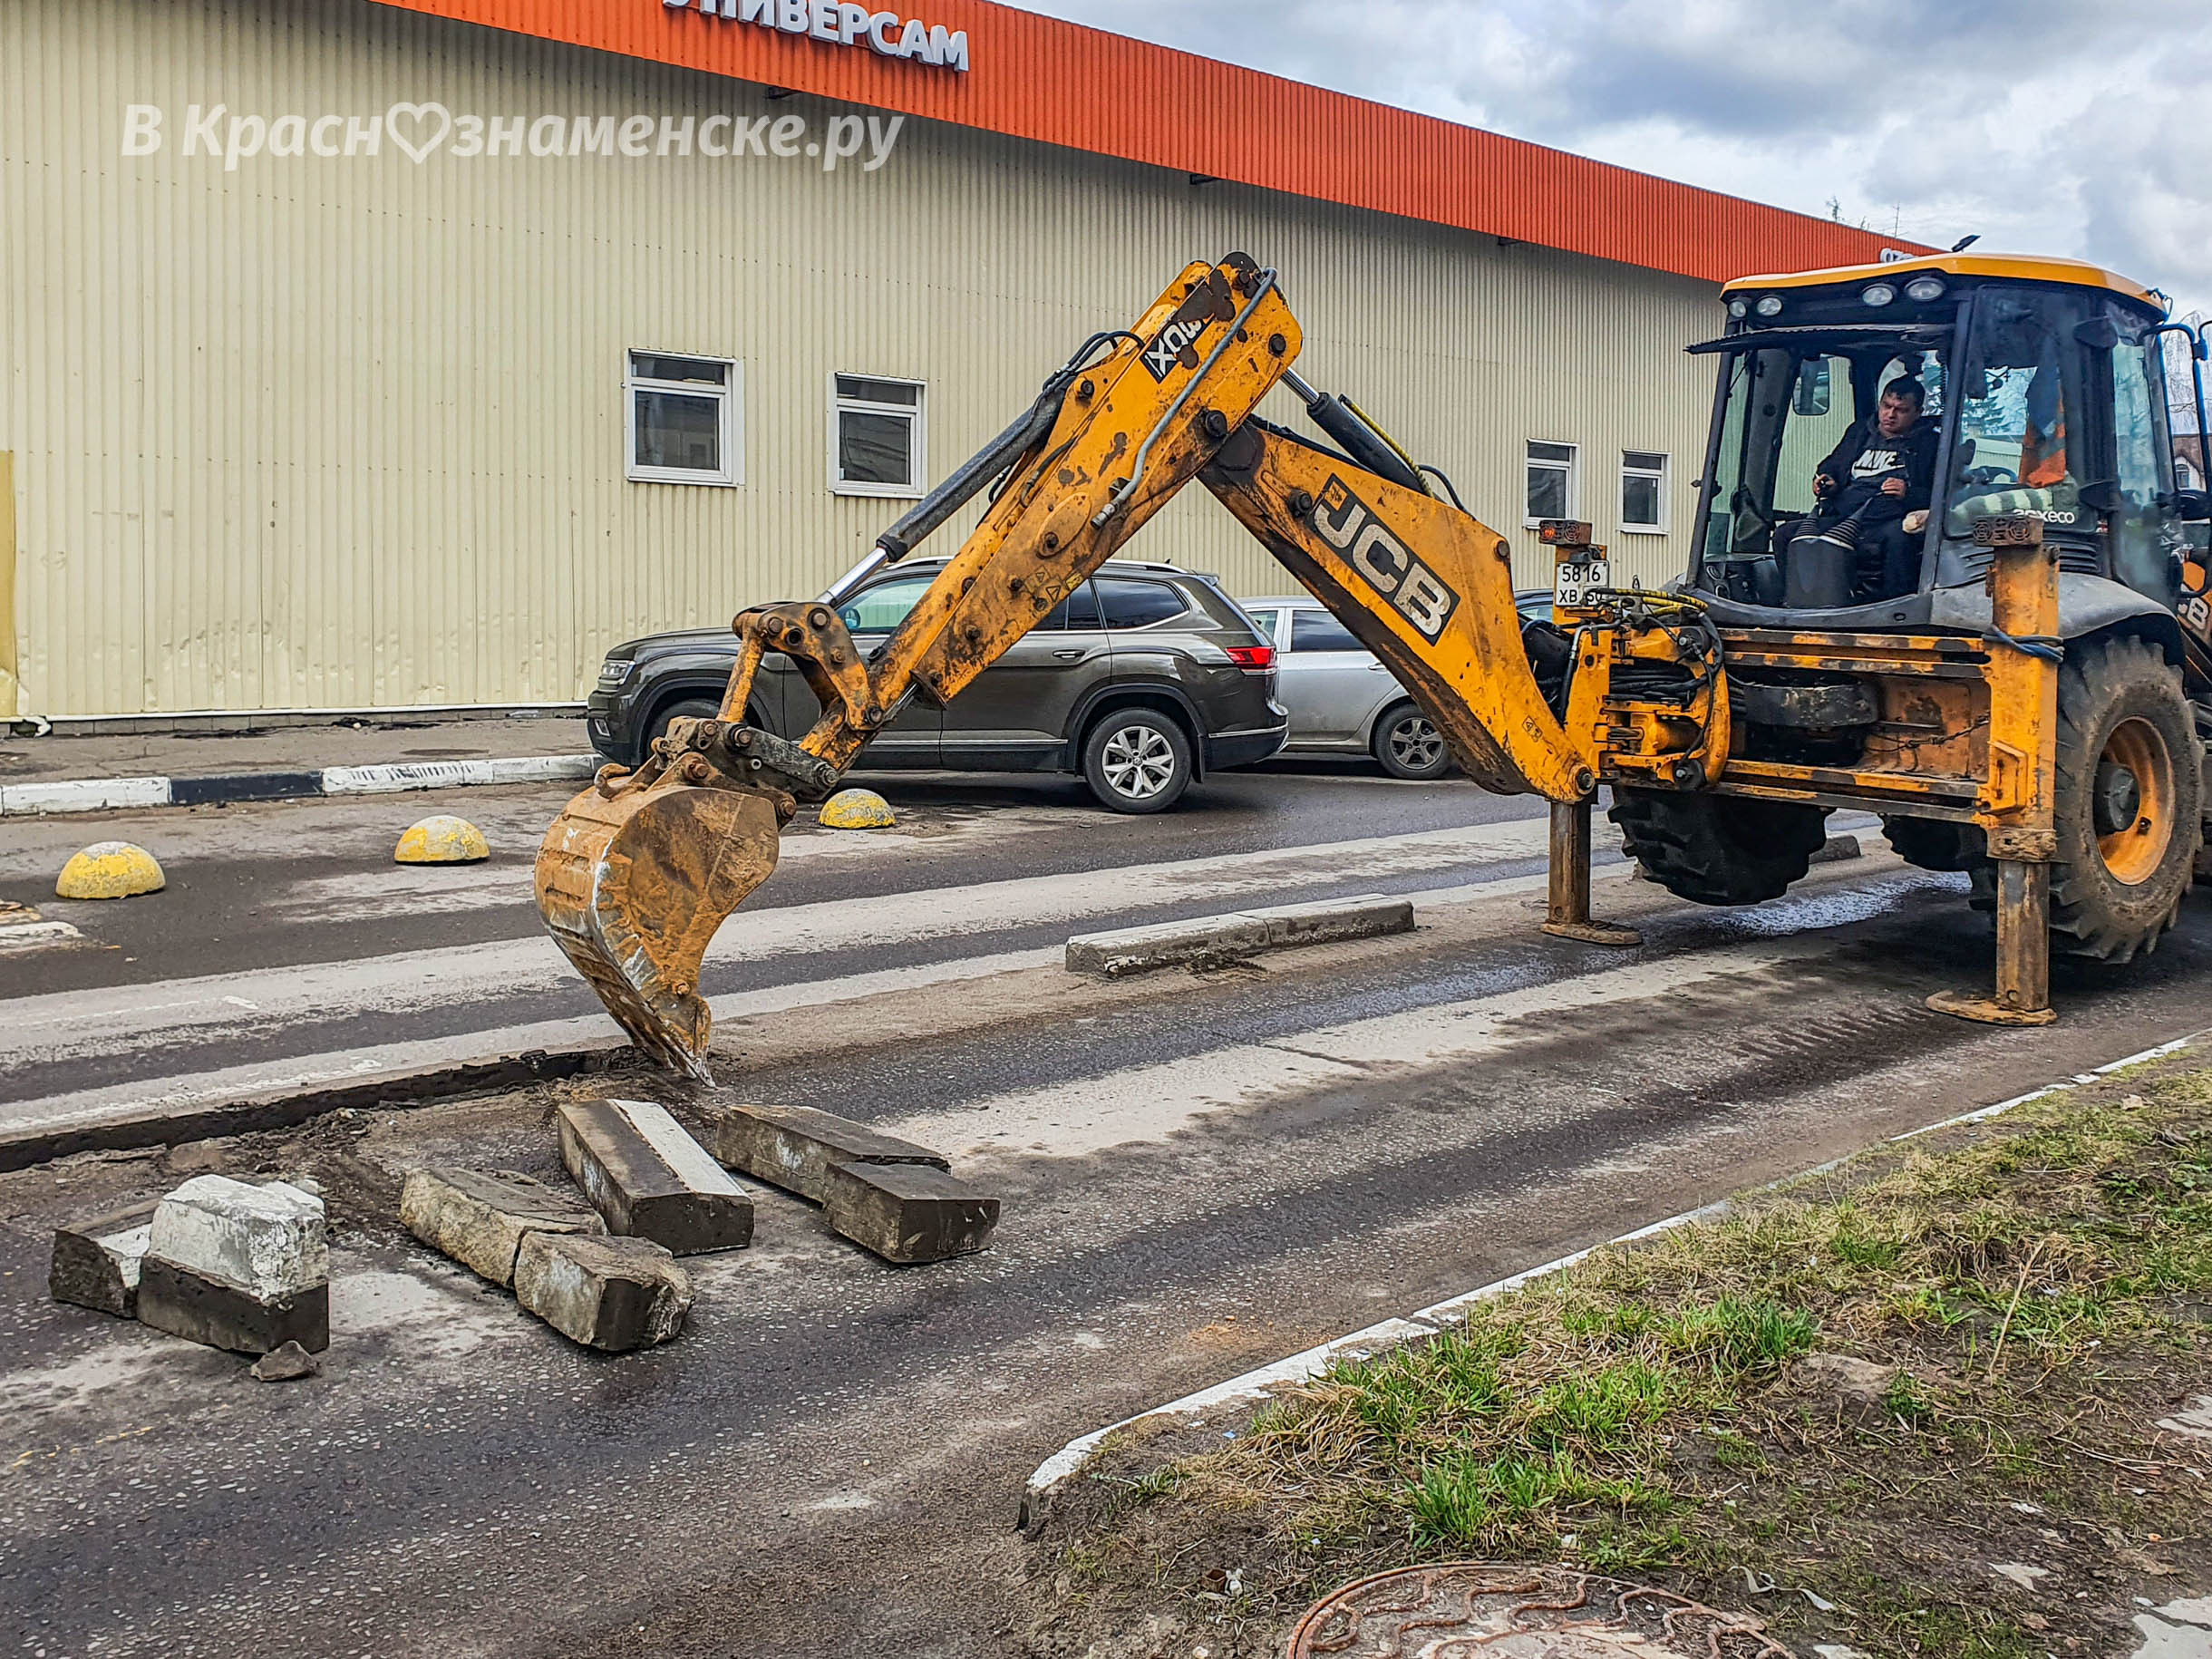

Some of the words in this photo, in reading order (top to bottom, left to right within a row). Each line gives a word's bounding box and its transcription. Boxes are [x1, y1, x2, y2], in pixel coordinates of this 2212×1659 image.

[1855, 449, 1898, 469] NIKE
[1315, 502, 1450, 635] JCB
[1562, 565, 1601, 582] 5816
